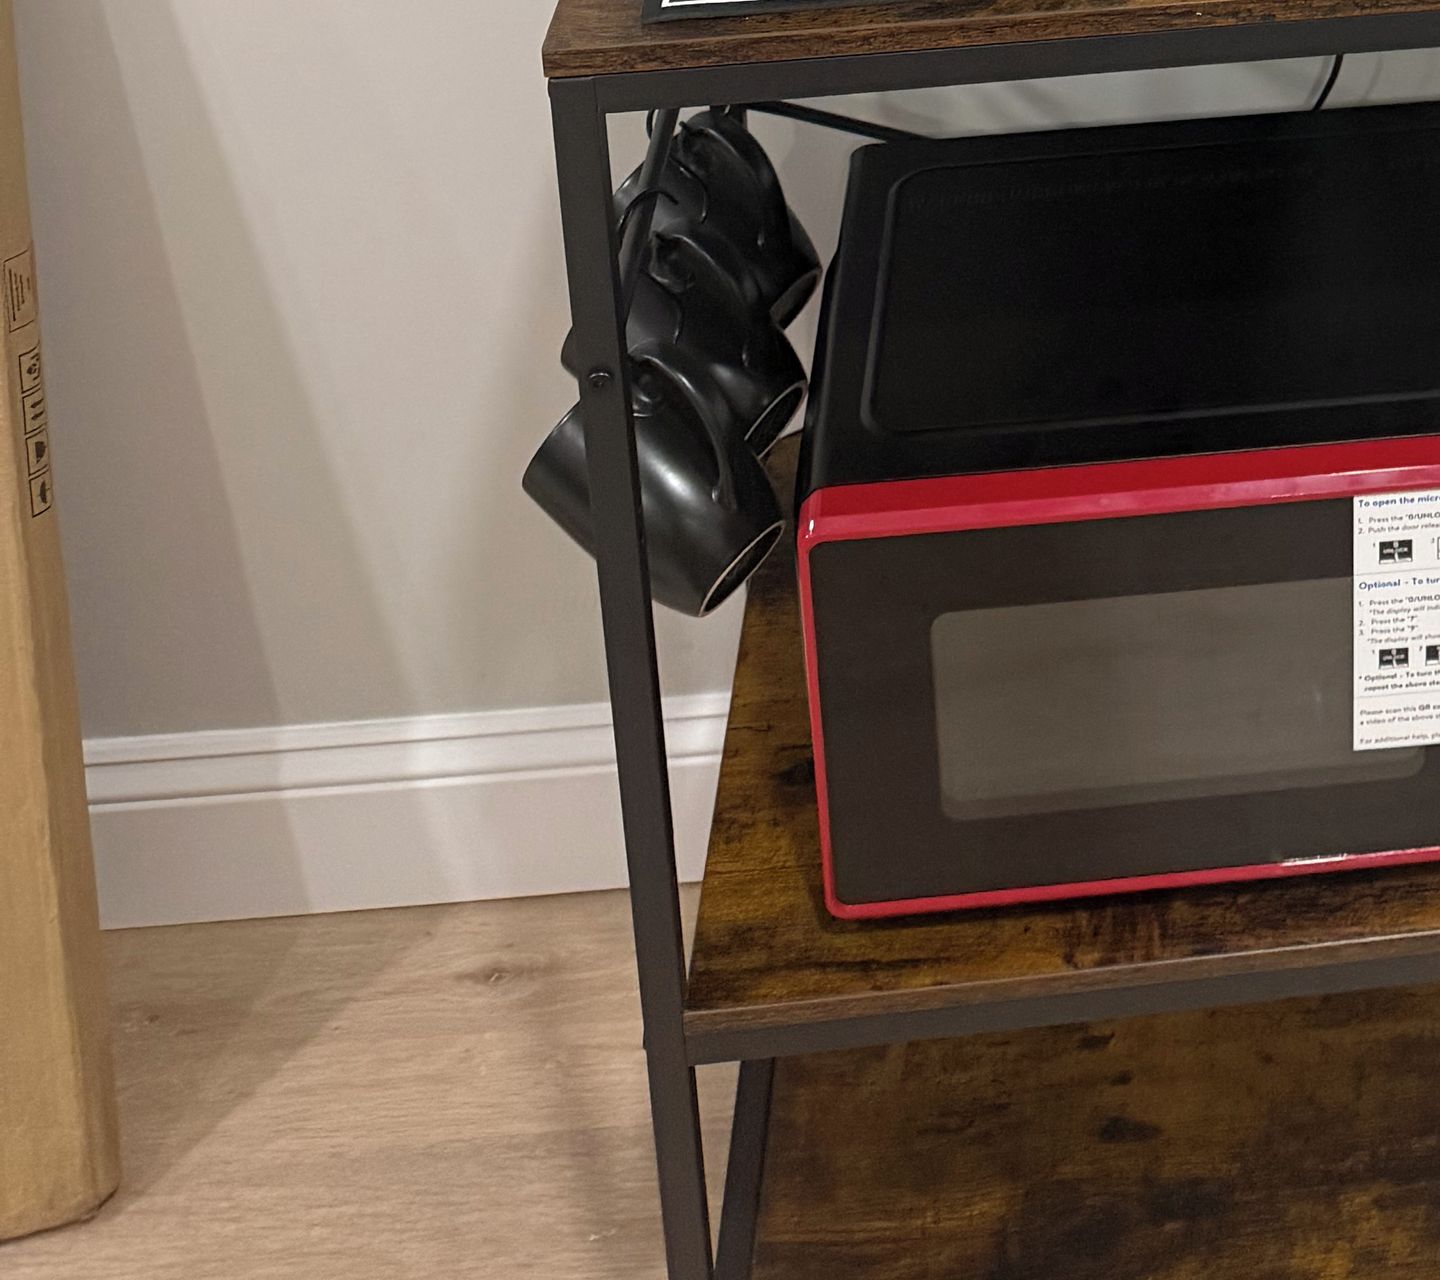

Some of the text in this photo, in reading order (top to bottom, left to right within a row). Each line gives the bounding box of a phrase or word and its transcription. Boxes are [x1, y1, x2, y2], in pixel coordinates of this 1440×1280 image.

[1358, 499, 1370, 508] To
[1372, 498, 1397, 509] open
[1399, 496, 1415, 505] the
[1368, 516, 1389, 524] Press
[1368, 526, 1386, 534] Push
[1358, 578, 1401, 592] Optional
[1412, 577, 1424, 586] To
[1364, 672, 1397, 682] Optional
